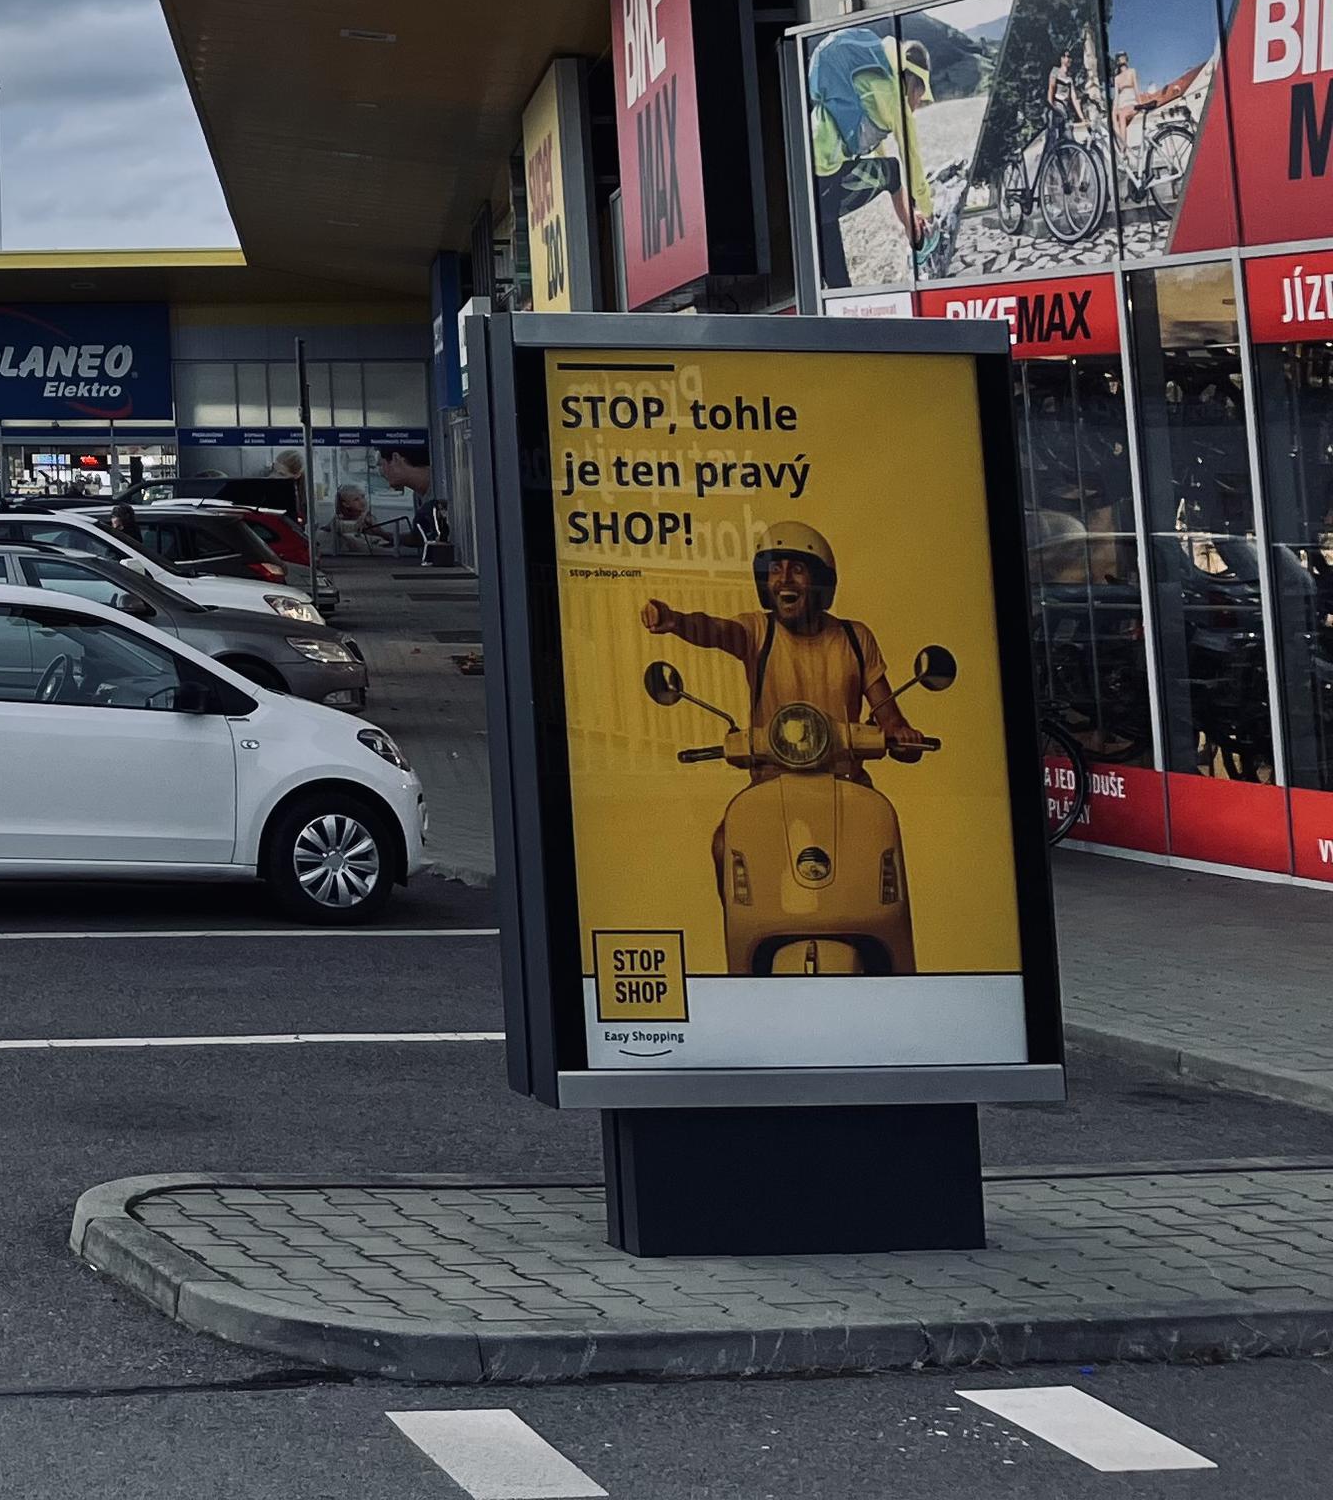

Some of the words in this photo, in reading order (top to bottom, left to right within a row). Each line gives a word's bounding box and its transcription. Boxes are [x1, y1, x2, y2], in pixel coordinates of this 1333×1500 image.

[637, 73, 685, 263] MAX
[43, 381, 122, 397] Elektro
[561, 395, 676, 435] STOP,
[690, 396, 798, 431] tohle
[561, 451, 601, 496] je
[613, 455, 681, 487] ten
[696, 454, 811, 499] pravý
[568, 511, 693, 546] SHOP!
[569, 567, 642, 580] stop-shop.com
[1055, 768, 1127, 799] JEDDUŠE
[613, 949, 666, 972] STOP
[615, 981, 667, 1004] SHOP
[605, 1031, 630, 1044] Easy
[632, 1031, 685, 1044] Shopping
